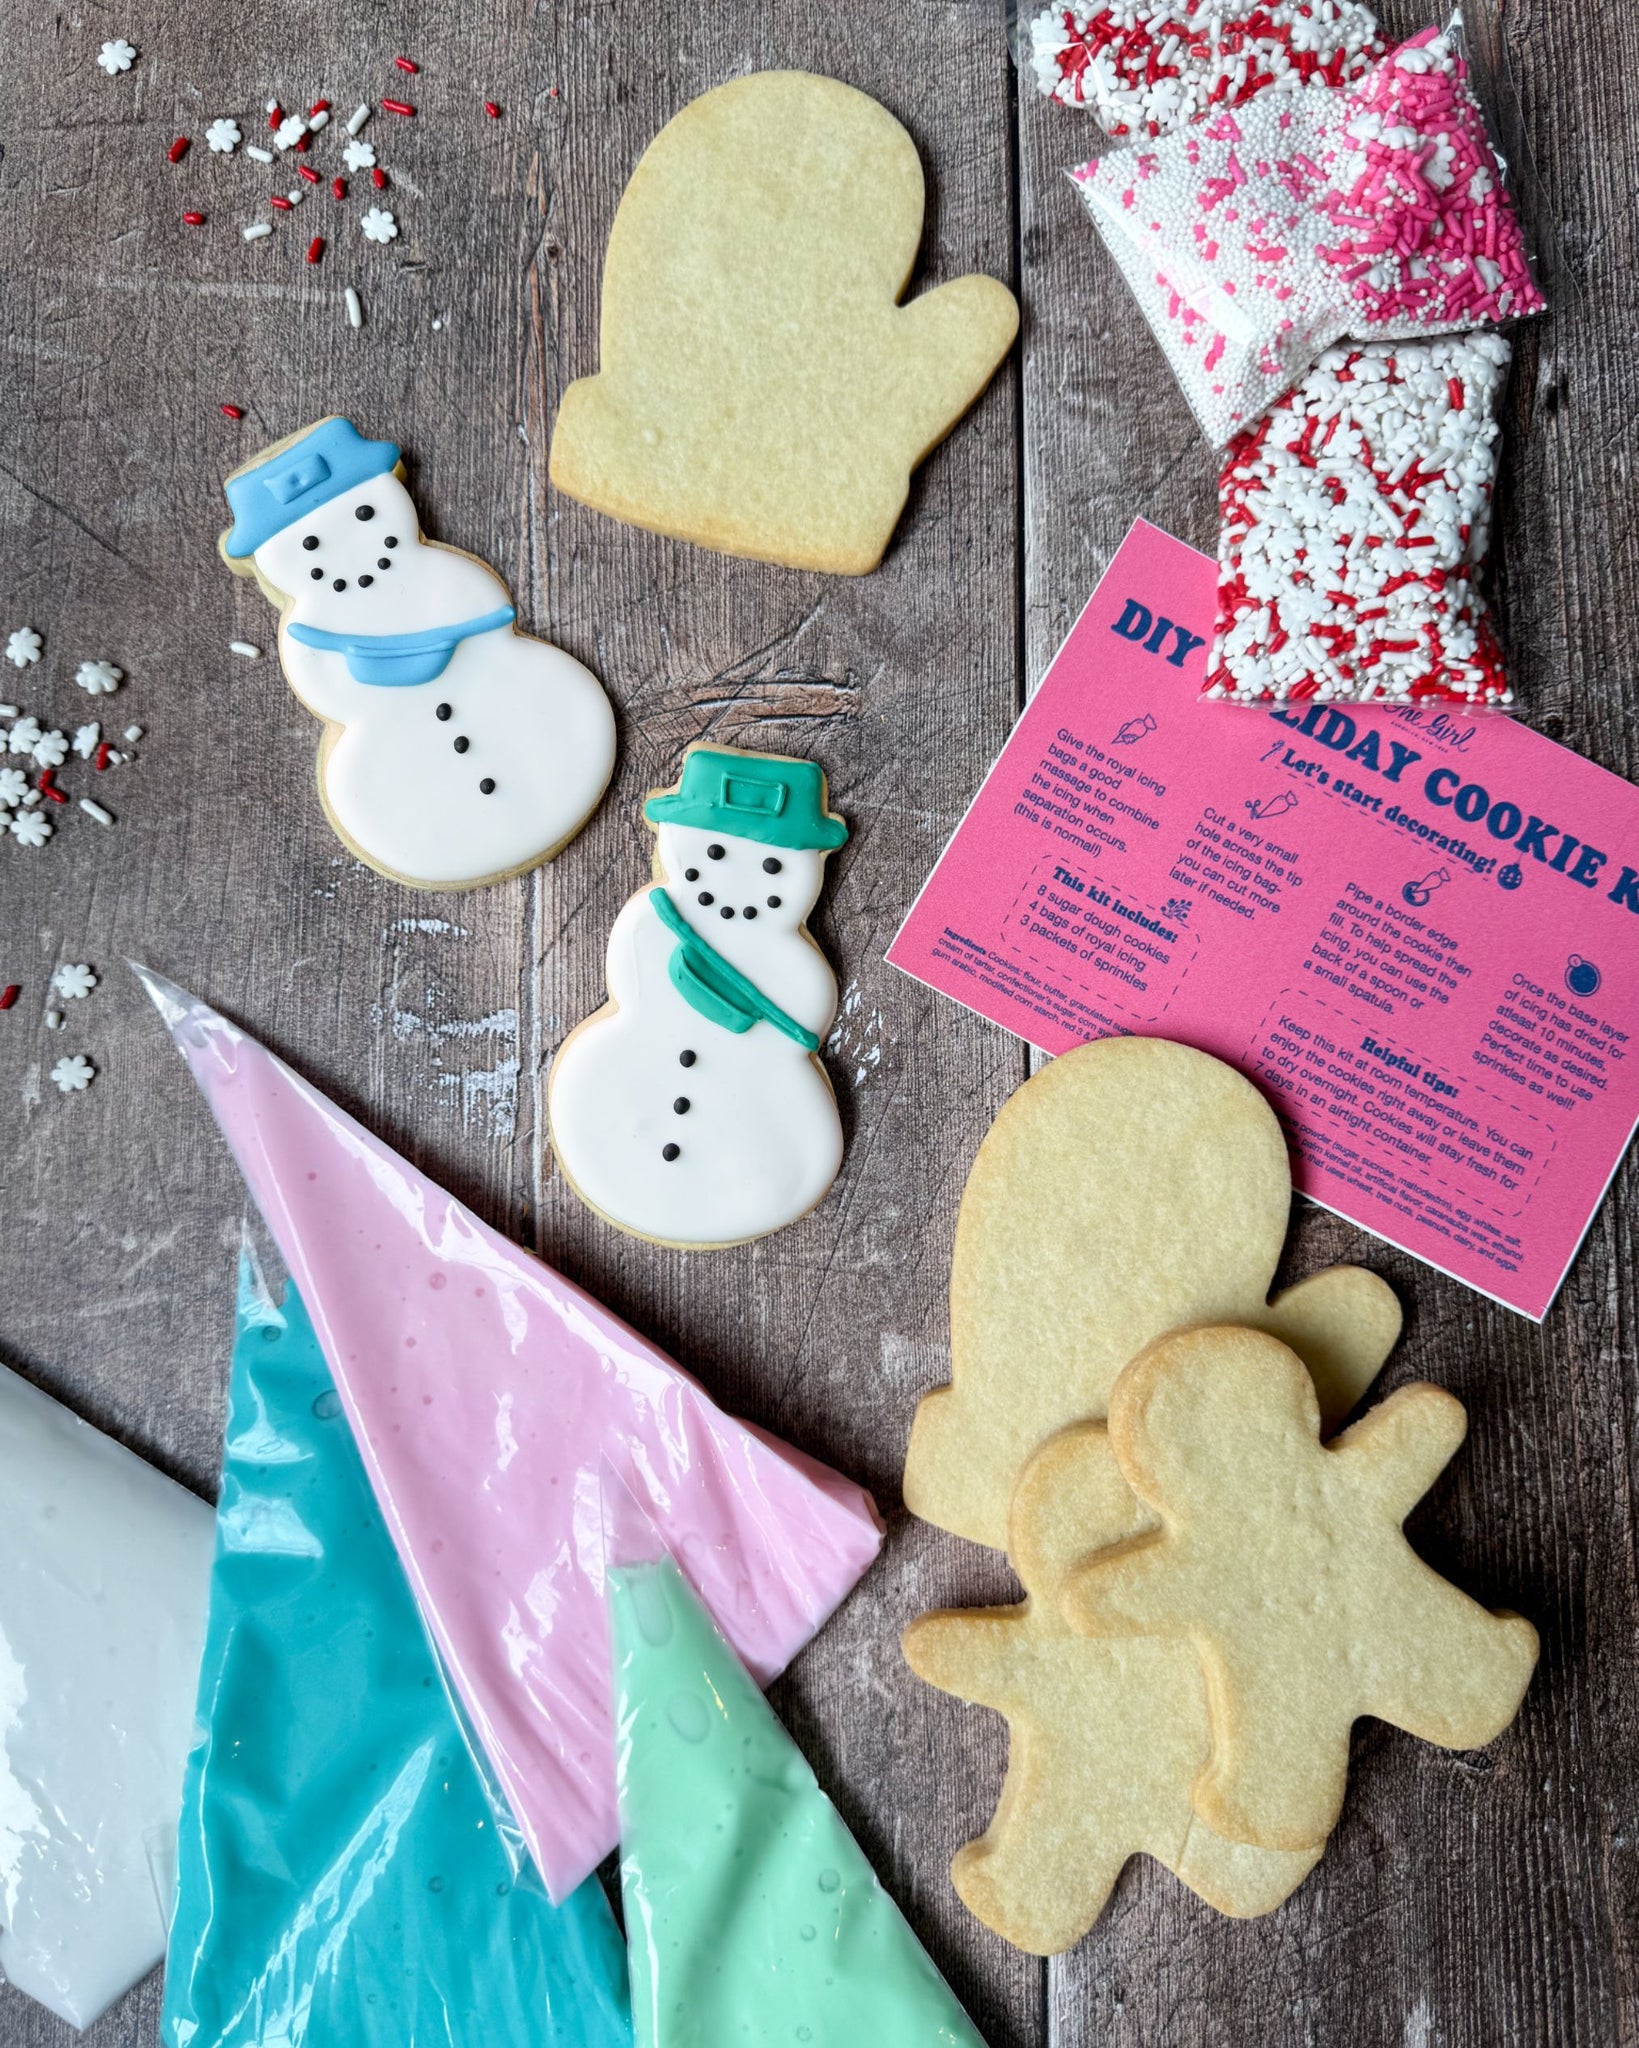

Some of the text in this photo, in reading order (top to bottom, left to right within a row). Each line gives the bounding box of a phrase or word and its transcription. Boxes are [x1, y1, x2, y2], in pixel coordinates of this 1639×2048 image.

[1047, 742, 1122, 790] bags a good
[1056, 727, 1166, 797] Give the royal icing
[1110, 598, 1206, 667] DIY
[1425, 768, 1607, 888] COOKIE
[1013, 801, 1102, 858] (this is normal!)
[1022, 788, 1127, 853] separation occurs.
[1031, 771, 1115, 825] the icing when
[1039, 759, 1160, 830] massage to combine
[1280, 747, 1497, 874] Let's start decorating!
[1185, 838, 1202, 850] of
[1201, 844, 1222, 863] the
[1221, 855, 1252, 881] icing
[1194, 820, 1303, 887] hole across the tip
[1203, 807, 1299, 864] Cut a very small
[1052, 865, 1178, 943] This kit includes:
[1168, 865, 1255, 920] later if needed.
[1175, 853, 1280, 913] you can cut more
[1344, 881, 1458, 951] Pipe a border edge
[1019, 913, 1148, 992] 3 packets of sprinkles
[1028, 900, 1146, 973] 4 bags of royal icing
[1036, 883, 1170, 964] 8 sugar dough cookies
[1328, 912, 1458, 989] fill. To help spread the
[1335, 899, 1472, 978] around the cookie then
[1302, 959, 1394, 1015] a small spatula.
[1311, 941, 1425, 1009] back of a spoon or
[1319, 927, 1449, 1004] icing, you can use the
[1503, 989, 1627, 1060] of icing has dried for
[1511, 972, 1630, 1043] Once the base layer
[1540, 1026, 1555, 1042] 10
[1277, 1014, 1533, 1160] Keep this kit at room temperature. You can
[1359, 1036, 1459, 1099] Helpful tips:
[1471, 1050, 1576, 1111] sprinkles as well!
[1480, 1032, 1594, 1101] Perfect time to use
[1488, 1020, 1608, 1091] decorate as desired.
[1253, 1060, 1432, 1166] 7 days in an airtight container.
[1261, 1045, 1519, 1190] to dry overnight. Cookies will stay fresh for
[1269, 1032, 1525, 1176] enjoy the cookies right away or leave them
